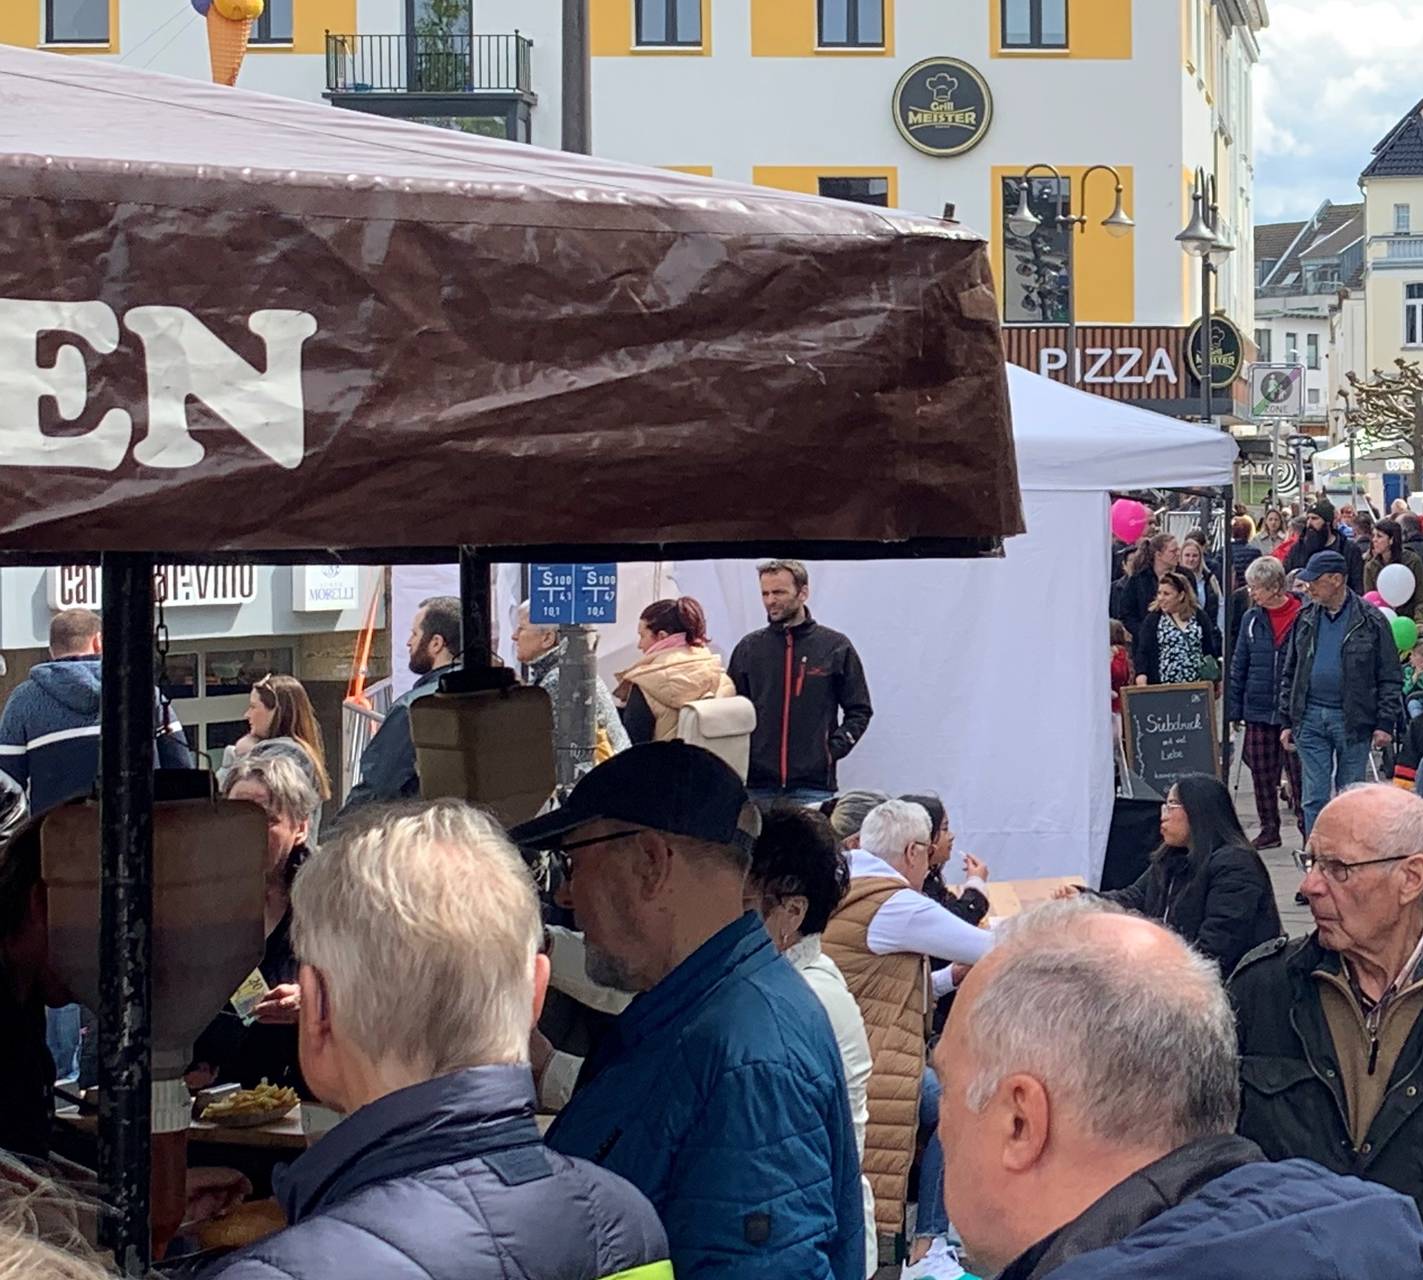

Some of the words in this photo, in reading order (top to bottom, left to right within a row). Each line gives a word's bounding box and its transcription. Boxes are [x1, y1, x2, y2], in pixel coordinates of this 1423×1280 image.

[930, 101, 955, 112] Grill
[907, 111, 977, 125] MEISTER
[1040, 347, 1178, 385] PIZZA
[309, 587, 354, 600] MORELLI
[1145, 713, 1203, 733] Siebdruck
